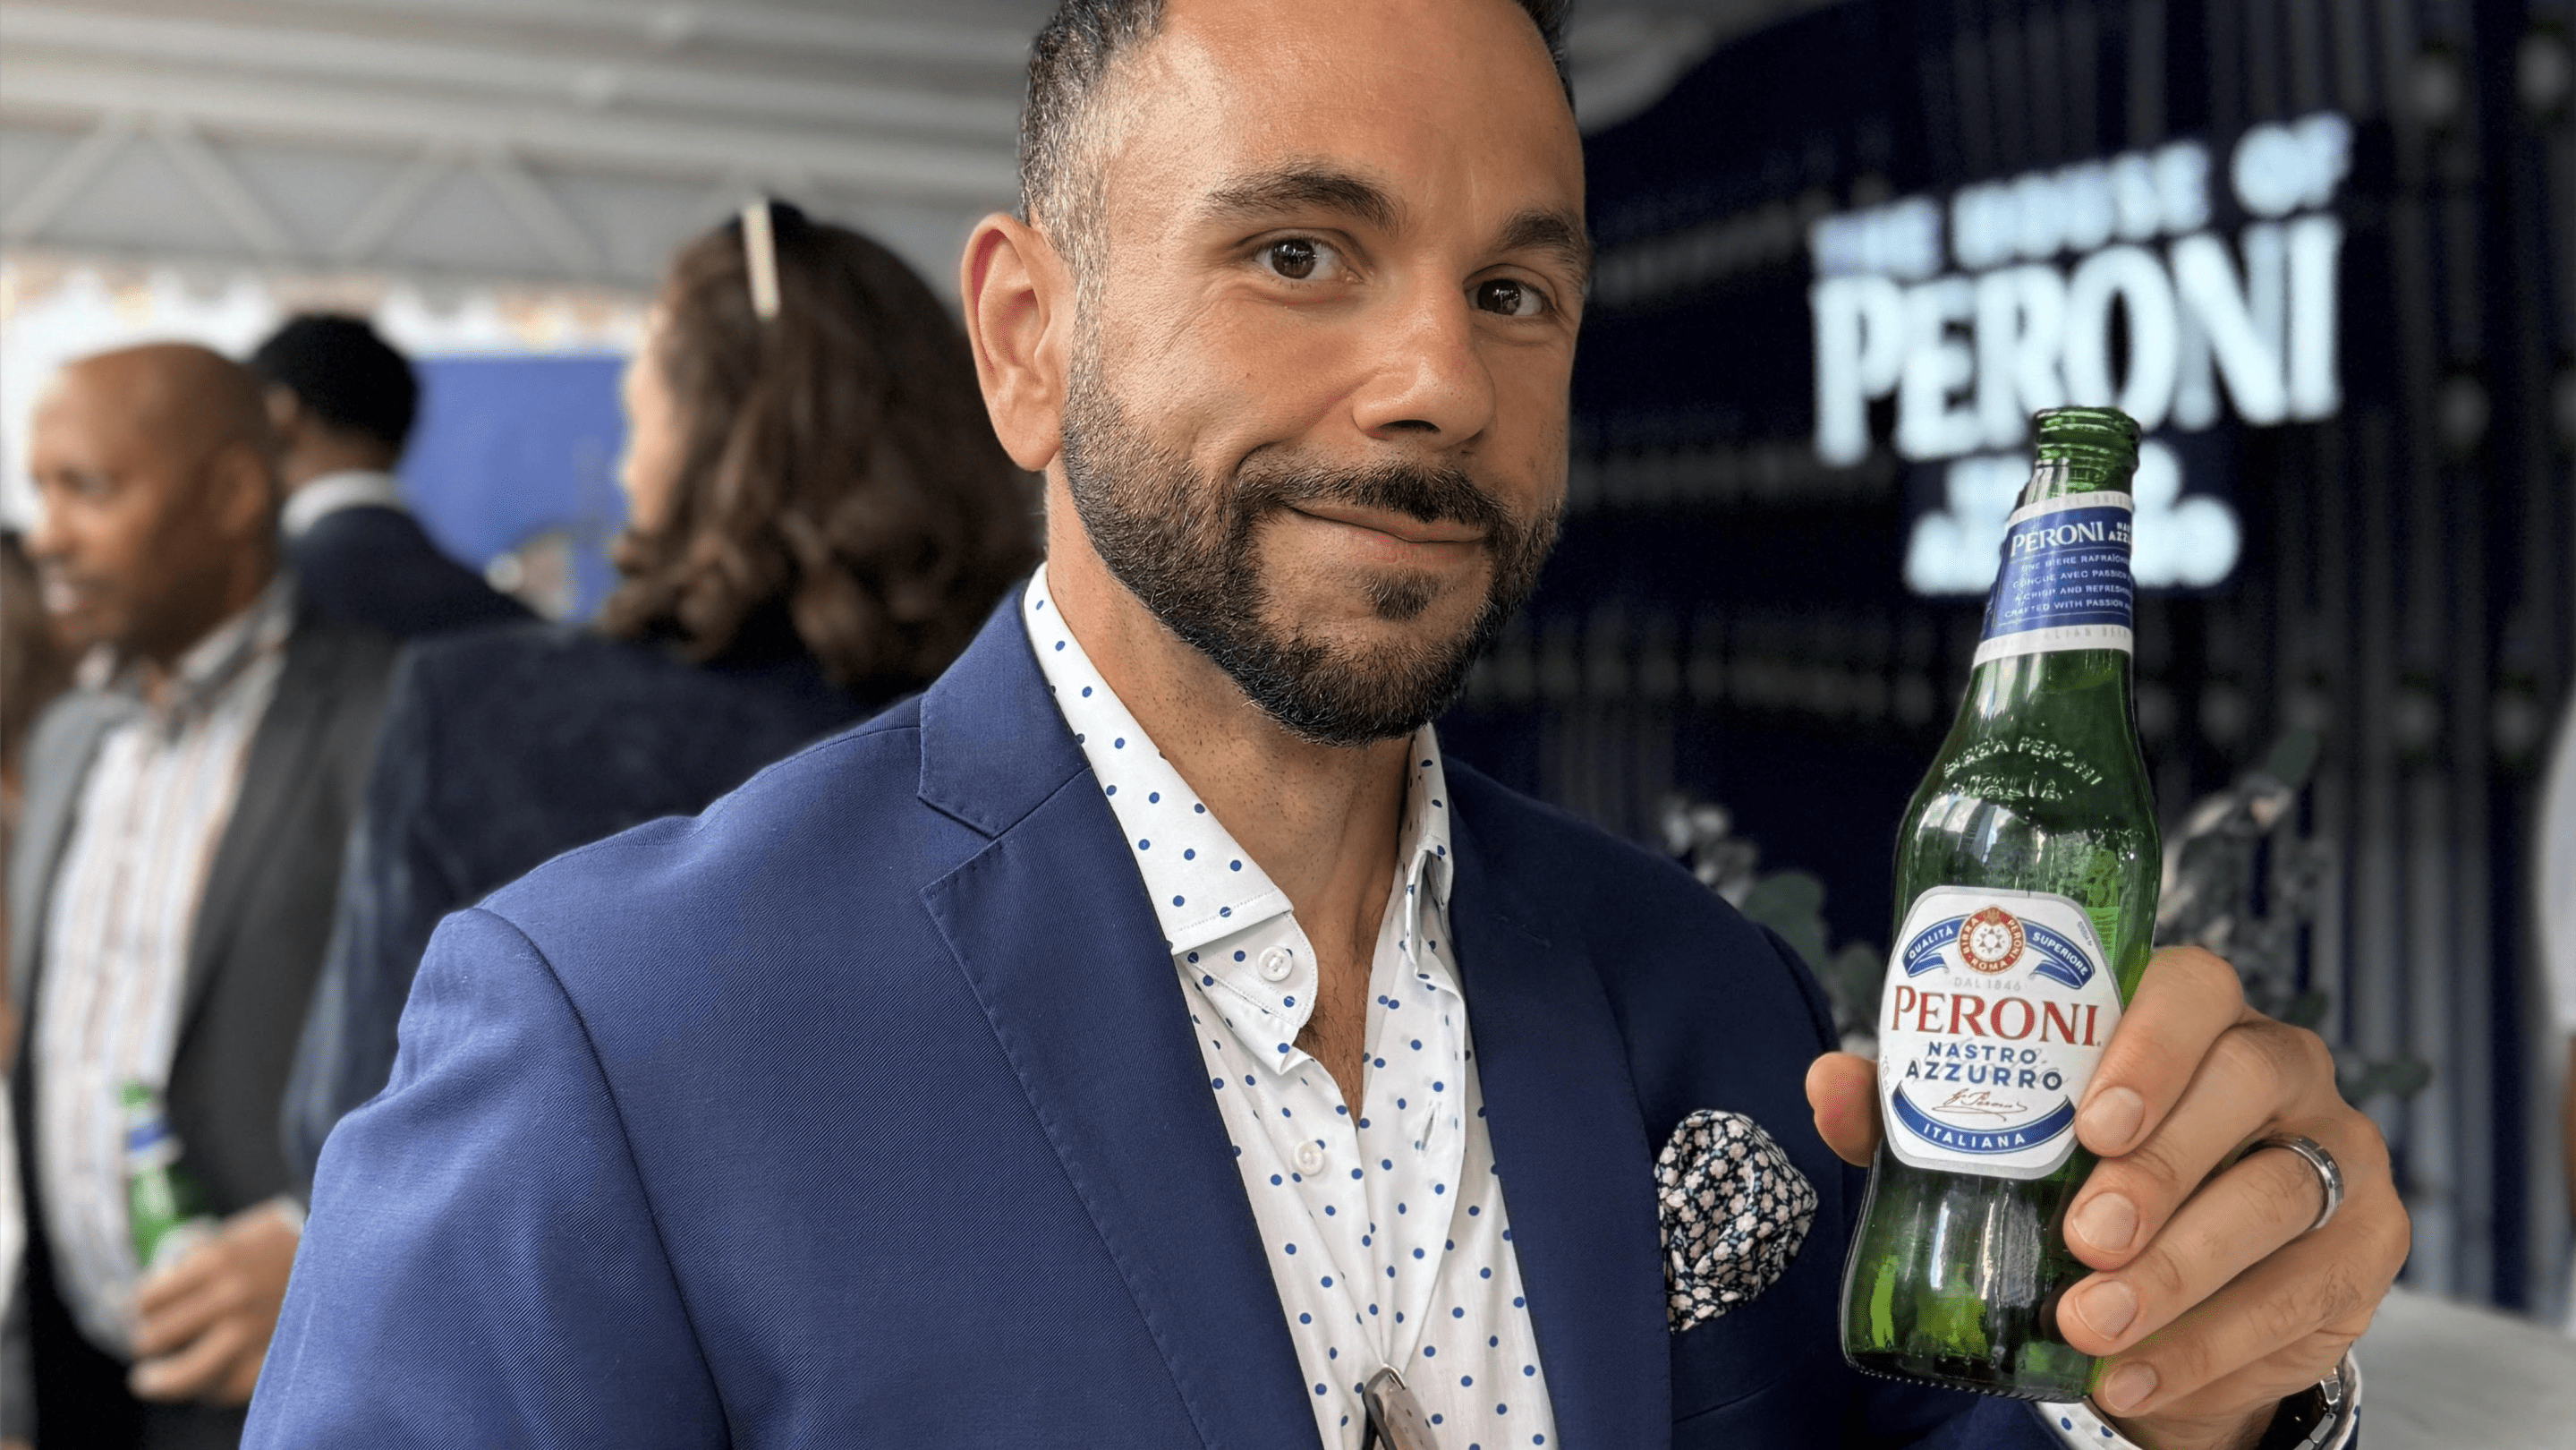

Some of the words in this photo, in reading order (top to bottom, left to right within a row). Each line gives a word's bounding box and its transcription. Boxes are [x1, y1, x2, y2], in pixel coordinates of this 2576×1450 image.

[1809, 213, 2344, 466] PERONI
[2011, 521, 2104, 557] PERONI
[2061, 570, 2088, 580] AVEC
[2060, 585, 2082, 594] AND
[2053, 600, 2083, 610] WITH
[1960, 917, 1980, 955] BIRRA
[2007, 918, 2023, 960] PERONI
[1971, 958, 2007, 971] ROMA
[2032, 931, 2088, 977] SUPERIORE
[1954, 977, 1980, 989] DAL
[1987, 979, 2021, 991] 1846
[1891, 985, 2101, 1047] PERONI
[1927, 1041, 2037, 1065] NASTRO
[1905, 1060, 2063, 1091] AZZURRO
[1924, 1123, 2026, 1149] ITALIANA
